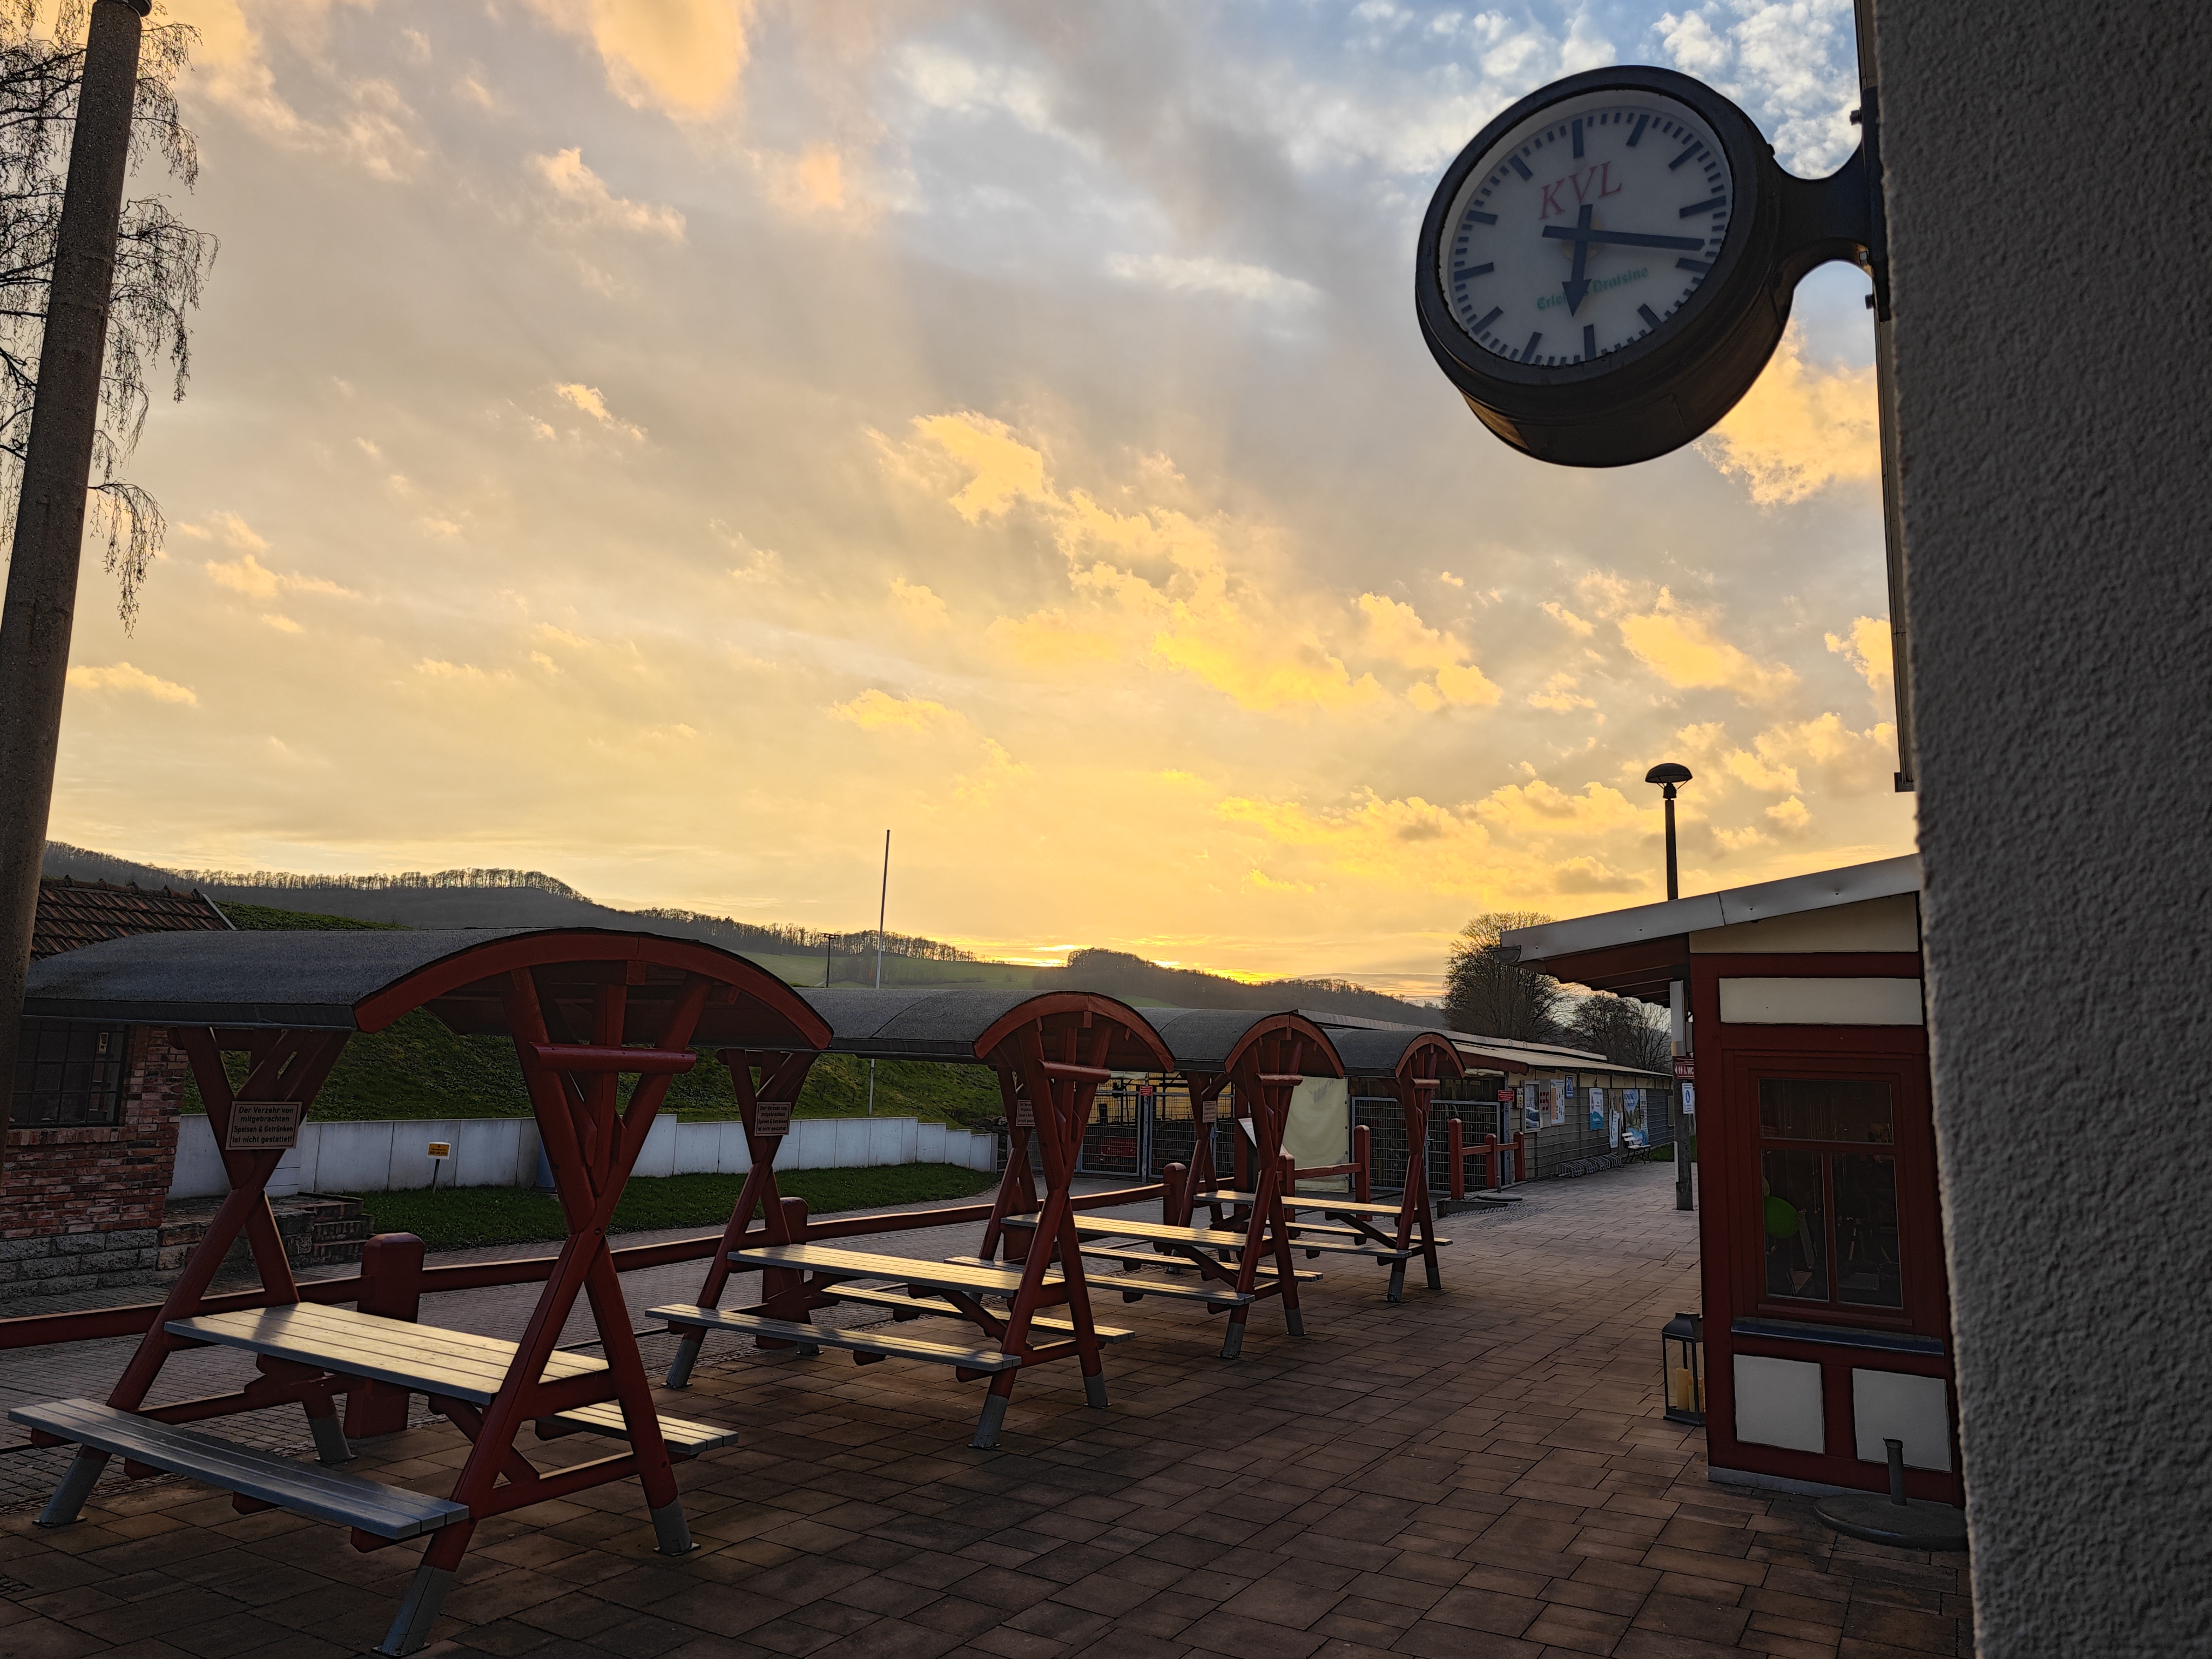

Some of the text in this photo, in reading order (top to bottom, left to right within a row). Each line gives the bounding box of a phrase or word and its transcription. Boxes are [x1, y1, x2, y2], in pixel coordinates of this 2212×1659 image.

[1539, 161, 1622, 220] KVL
[1593, 267, 1648, 293] Draisine
[1687, 1067, 1694, 1075] WC
[240, 1115, 289, 1123] mitgebrachten
